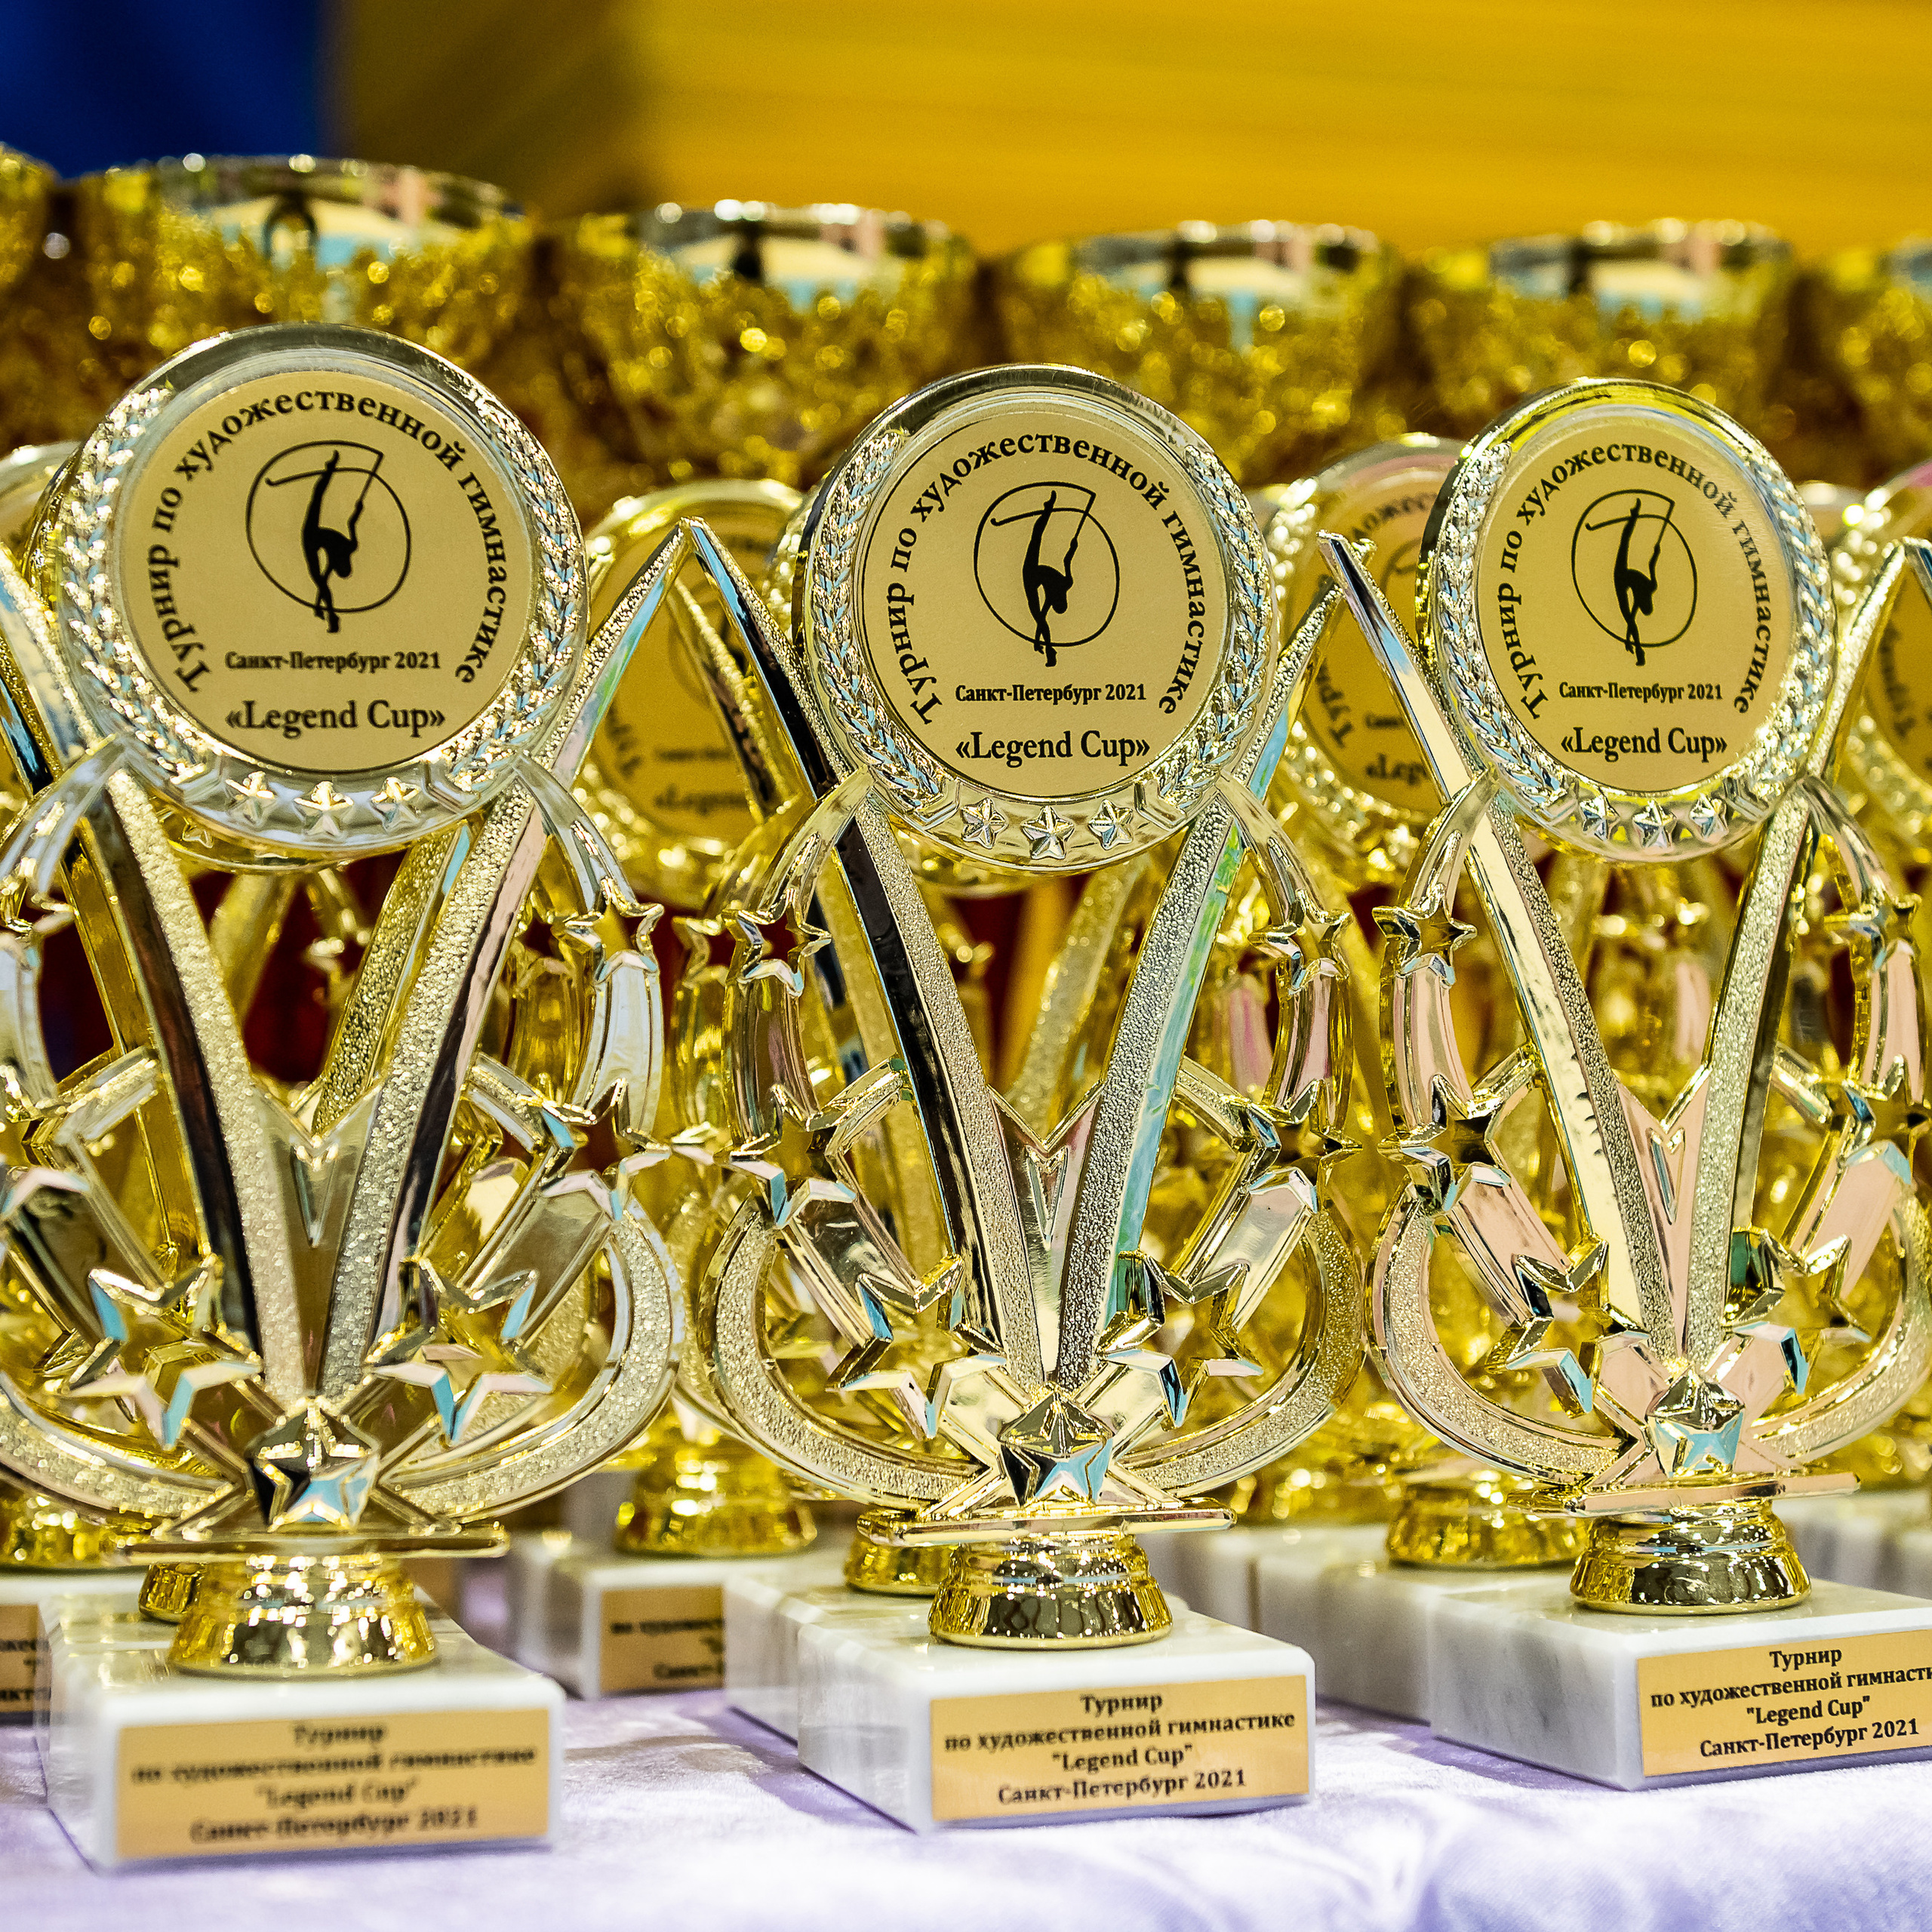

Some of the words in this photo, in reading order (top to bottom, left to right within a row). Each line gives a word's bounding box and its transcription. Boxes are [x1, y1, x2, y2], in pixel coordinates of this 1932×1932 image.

[174, 389, 466, 481] художественной
[910, 433, 1170, 521] художественной
[1516, 442, 1737, 525] художественной
[152, 487, 183, 533] по
[891, 528, 917, 572] по
[1501, 530, 1523, 574] по
[455, 471, 507, 684] гимнастике
[147, 543, 210, 692] Турнир
[1158, 510, 1207, 714] гимнастике
[1732, 519, 1773, 714] гимнастике
[225, 651, 390, 674] Санкт-Петербург
[394, 651, 441, 669] 2021
[886, 583, 943, 724] Турнир
[1498, 583, 1549, 720] Турнир
[955, 684, 1102, 706] Санкт-Петербург
[1106, 684, 1146, 700] 2021
[1559, 681, 1684, 703] Санкт-Петербург
[1688, 685, 1722, 700] 2021
[226, 700, 358, 739] «Legend
[366, 700, 445, 738] Cup»
[955, 731, 1073, 768] «Legend
[1081, 730, 1150, 768] Cup»
[1561, 728, 1662, 763] «Legend
[1668, 728, 1727, 763] Cup»
[1769, 1648, 1842, 1670] Турнир
[1080, 1693, 1162, 1715] Турнир
[1651, 1693, 1675, 1708] по
[1680, 1672, 1842, 1708] художественной
[1746, 1700, 1823, 1726] "Legend
[1827, 1695, 1870, 1718] Cup"
[945, 1736, 971, 1751] по
[978, 1717, 1161, 1750] художественной
[1168, 1712, 1295, 1735] гимнастике
[1700, 1726, 1867, 1758] Санкт-Петербург
[1872, 1718, 1919, 1739] 2021
[998, 1776, 1189, 1805] Санкт-Петербург
[1195, 1768, 1246, 1789] 2021
